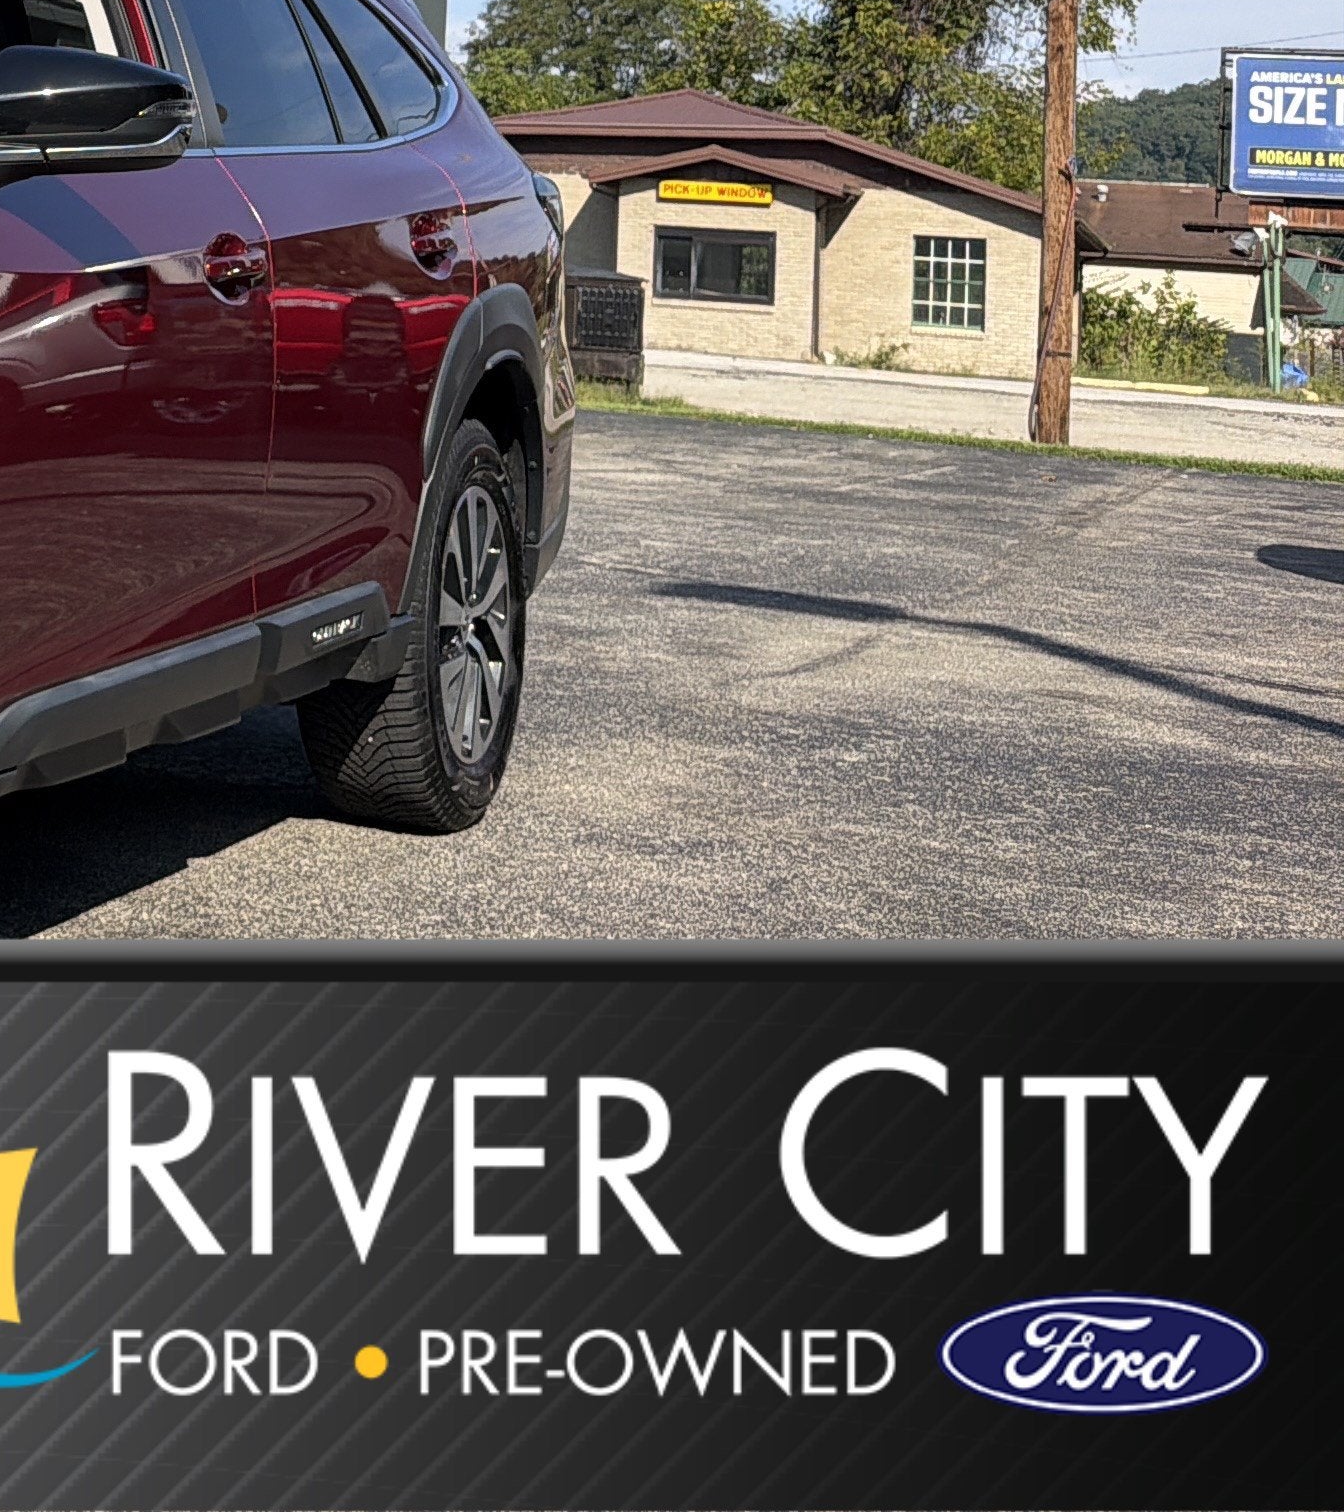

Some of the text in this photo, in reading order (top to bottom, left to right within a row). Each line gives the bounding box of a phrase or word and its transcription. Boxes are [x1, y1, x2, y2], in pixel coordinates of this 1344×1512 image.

[1251, 71, 1344, 85] AMERICA'S LA
[1249, 86, 1328, 126] SIZE
[1255, 149, 1312, 166] MORGAN
[1315, 152, 1325, 167] &
[717, 186, 767, 199] WINDOW
